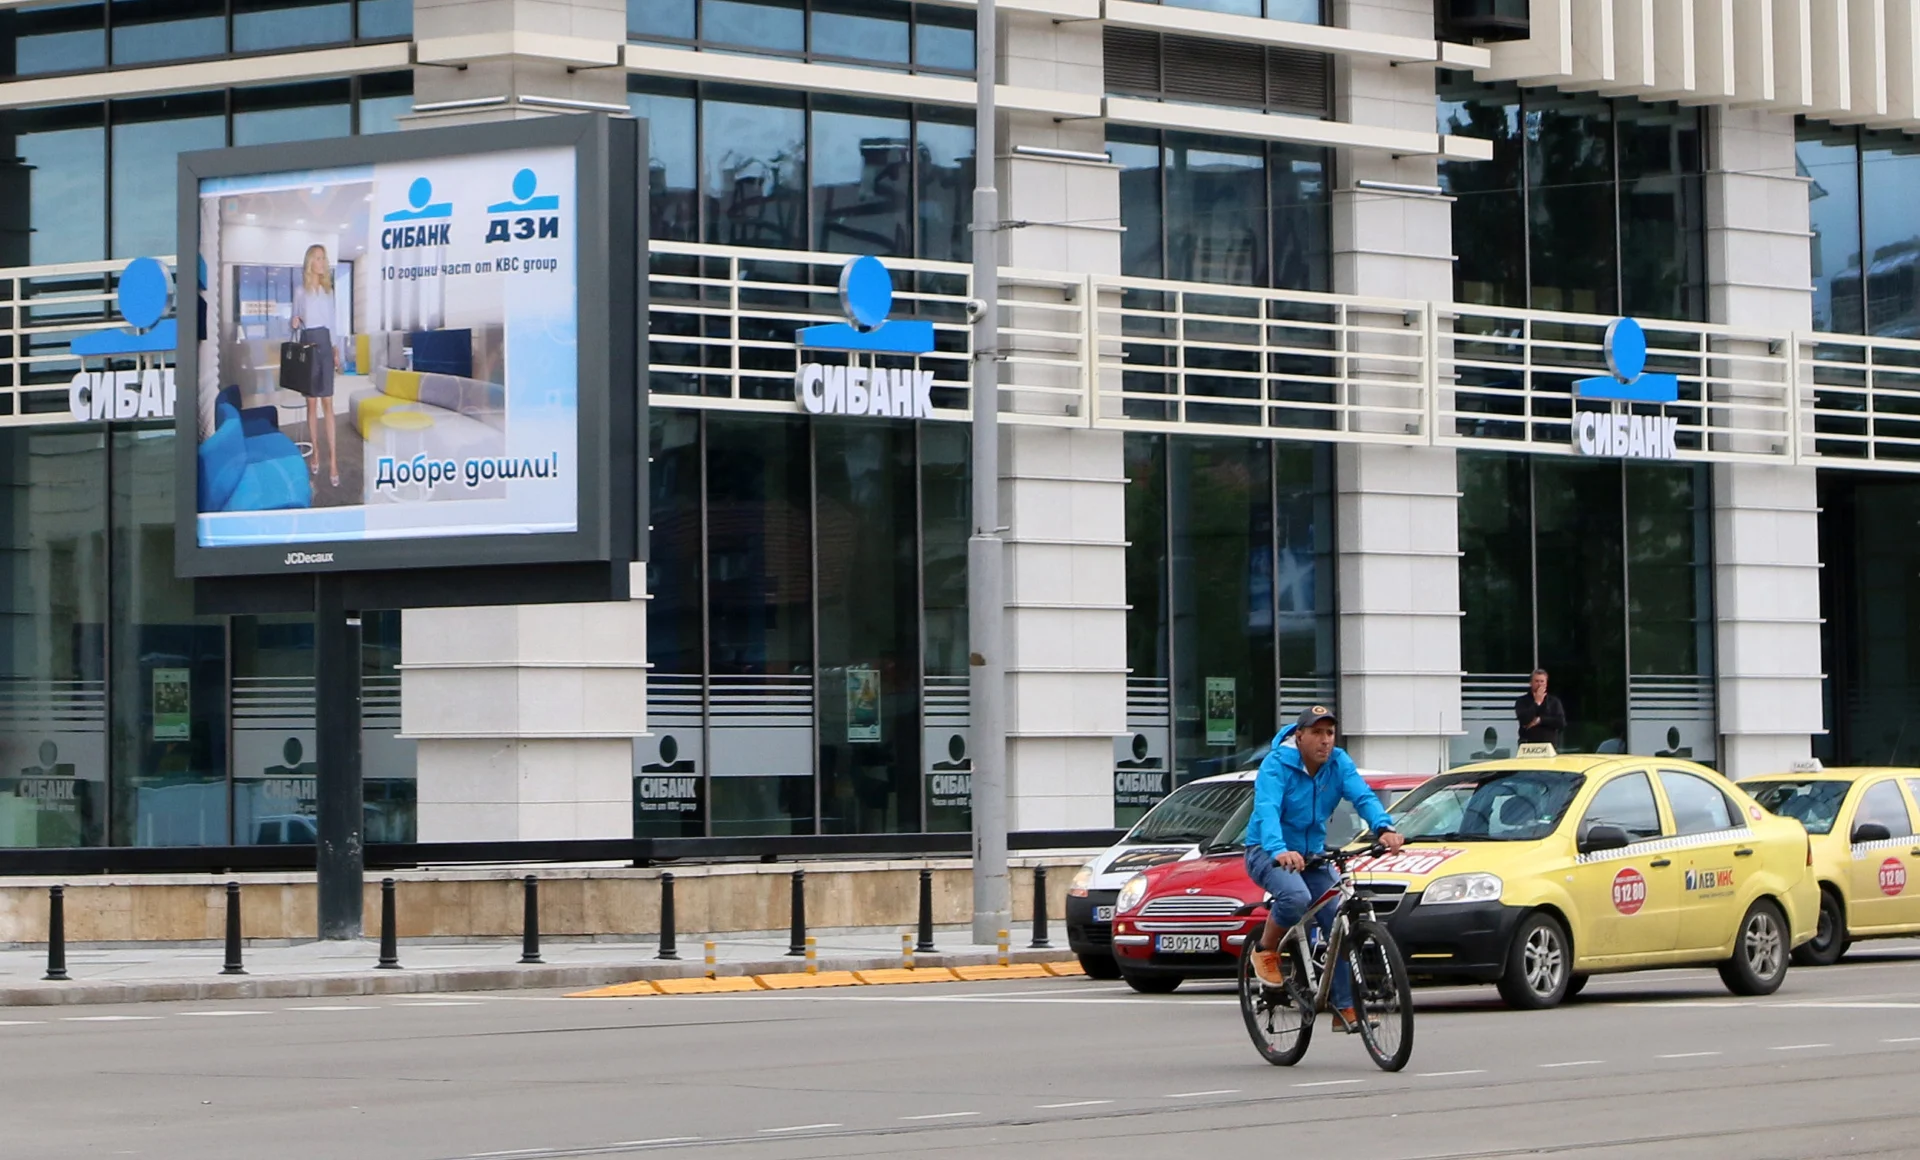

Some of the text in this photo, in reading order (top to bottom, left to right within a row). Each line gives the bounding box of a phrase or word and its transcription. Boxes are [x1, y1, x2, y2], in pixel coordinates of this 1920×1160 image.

[381, 223, 453, 250] СИБАНК
[485, 217, 559, 244] ДЗИ
[381, 257, 557, 281] 10 години част от KBC group
[795, 363, 935, 418] СИБАНК
[1571, 411, 1678, 459] СИБАНК
[375, 451, 558, 489] Добре дошли!
[284, 552, 334, 565] JCDecaux
[1521, 745, 1547, 755] ТАКСИ
[20, 779, 76, 800] СИБАНК
[641, 777, 697, 799] СИБАНК
[1116, 772, 1164, 792] СИБАНК
[1699, 869, 1734, 889] ЛЕВ ИНС
[1098, 907, 1111, 919] CB
[1161, 936, 1218, 950] CB 0912 AC
